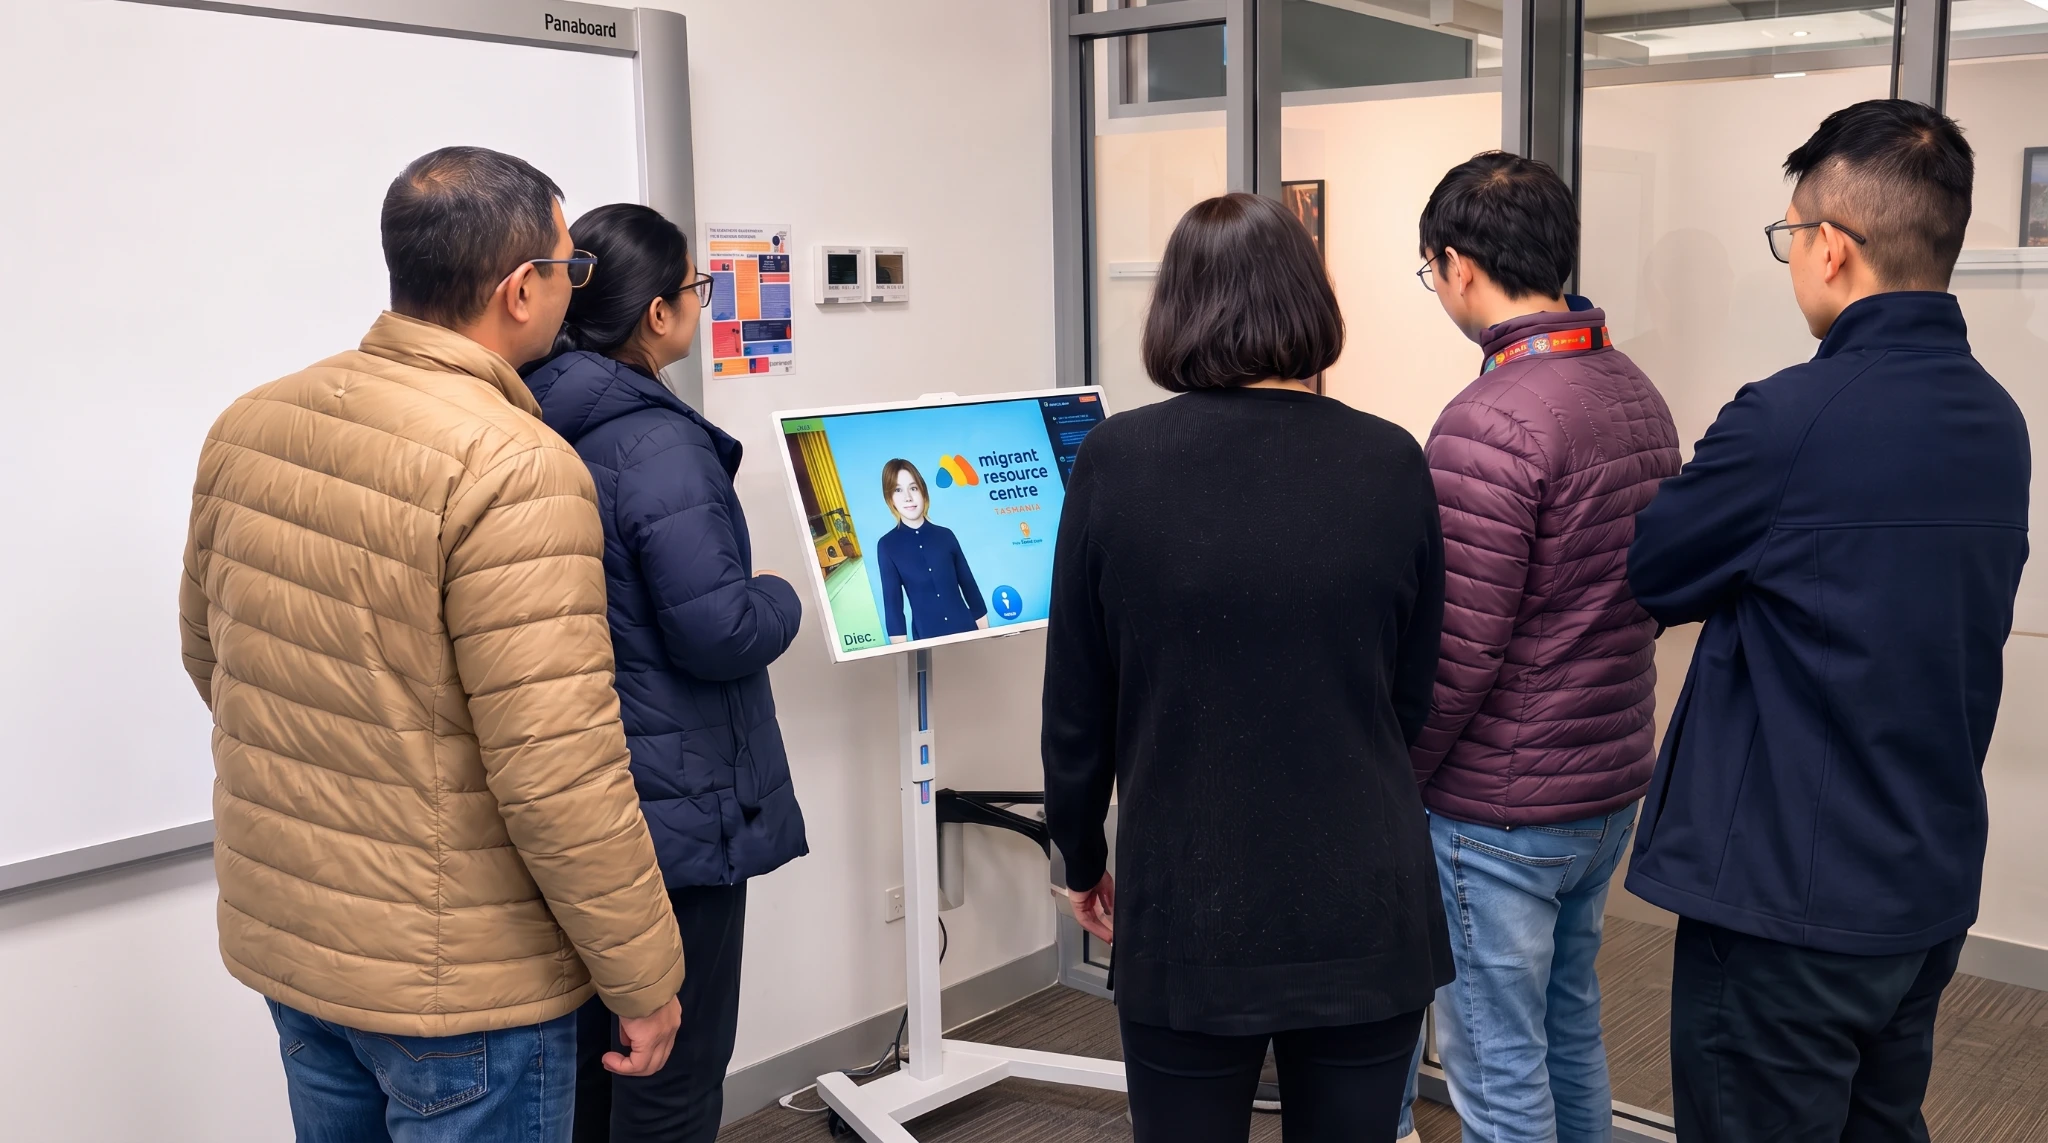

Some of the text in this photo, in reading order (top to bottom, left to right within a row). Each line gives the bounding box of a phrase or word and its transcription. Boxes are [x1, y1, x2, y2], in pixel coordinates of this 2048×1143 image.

[544, 13, 617, 38] Panaboard
[978, 448, 1040, 469] migrant
[983, 466, 1049, 485] resource
[989, 484, 1039, 501] centre
[994, 503, 1041, 515] TASMANIA
